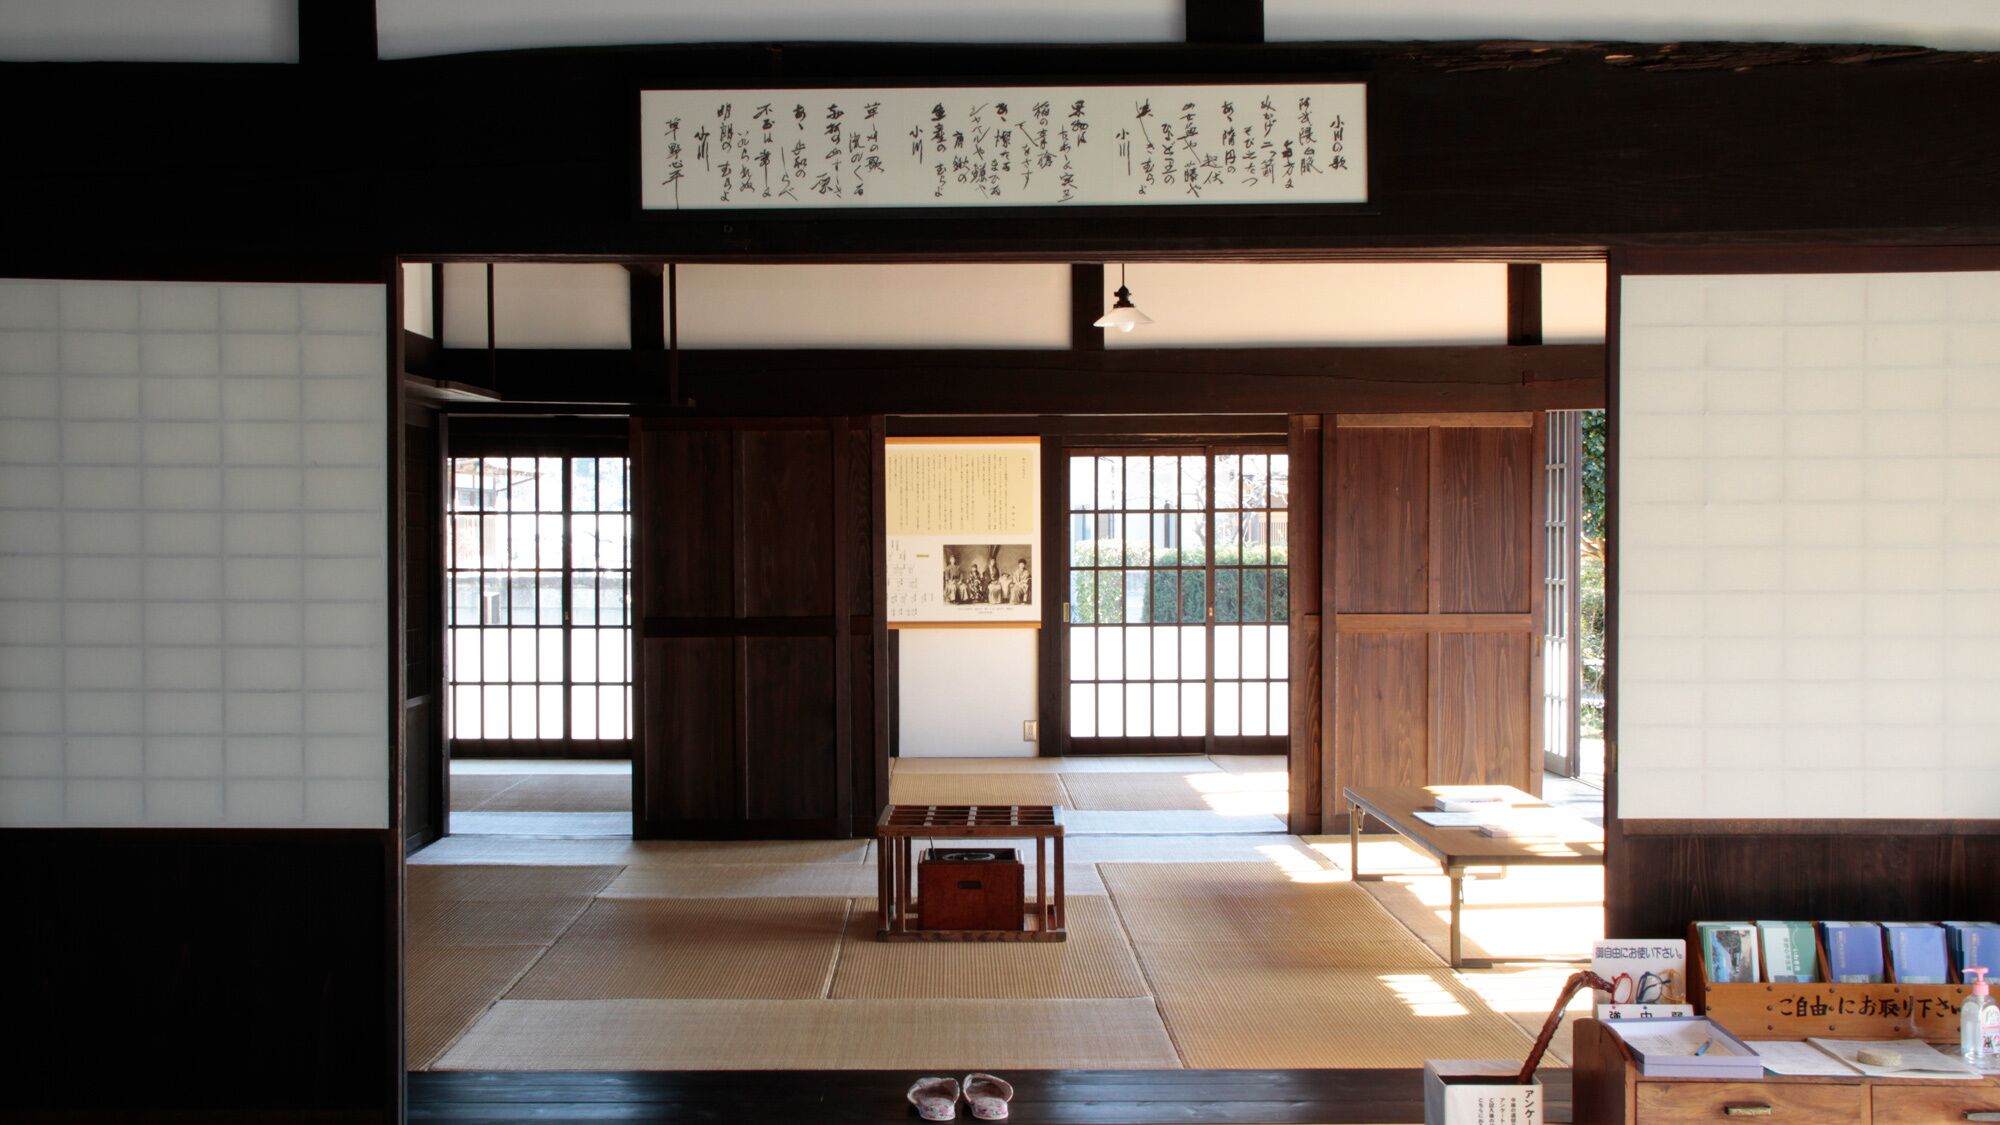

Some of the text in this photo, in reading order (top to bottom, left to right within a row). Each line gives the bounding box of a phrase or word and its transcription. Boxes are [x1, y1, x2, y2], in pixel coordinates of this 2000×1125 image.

[1595, 946, 1683, 960] 御自由にお使い下さい。
